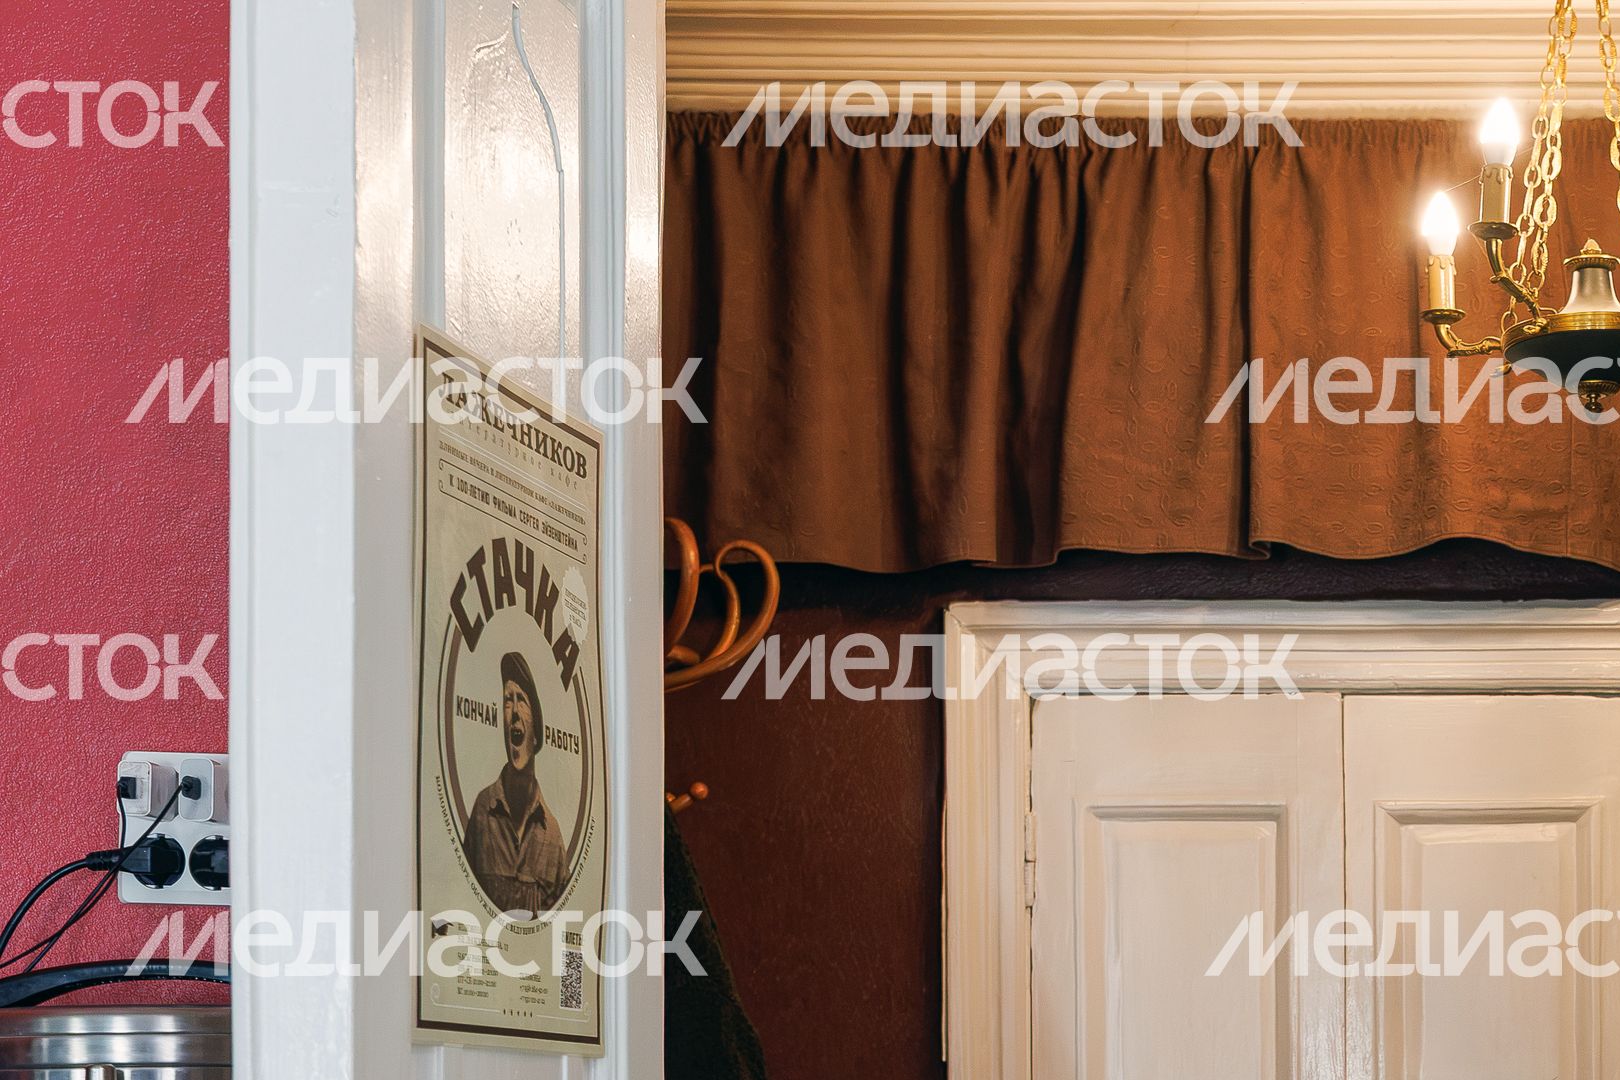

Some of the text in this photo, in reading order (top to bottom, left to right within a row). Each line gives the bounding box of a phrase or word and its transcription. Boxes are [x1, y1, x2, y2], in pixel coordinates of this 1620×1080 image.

[449, 410, 542, 469] тературное
[493, 495, 518, 519] ФИЛЬМА
[519, 509, 540, 531] СЕРГЕЯ
[450, 537, 580, 692] СТАЧКА
[456, 695, 498, 728] КОНЧАЙ
[545, 725, 579, 755] РАБОТУ
